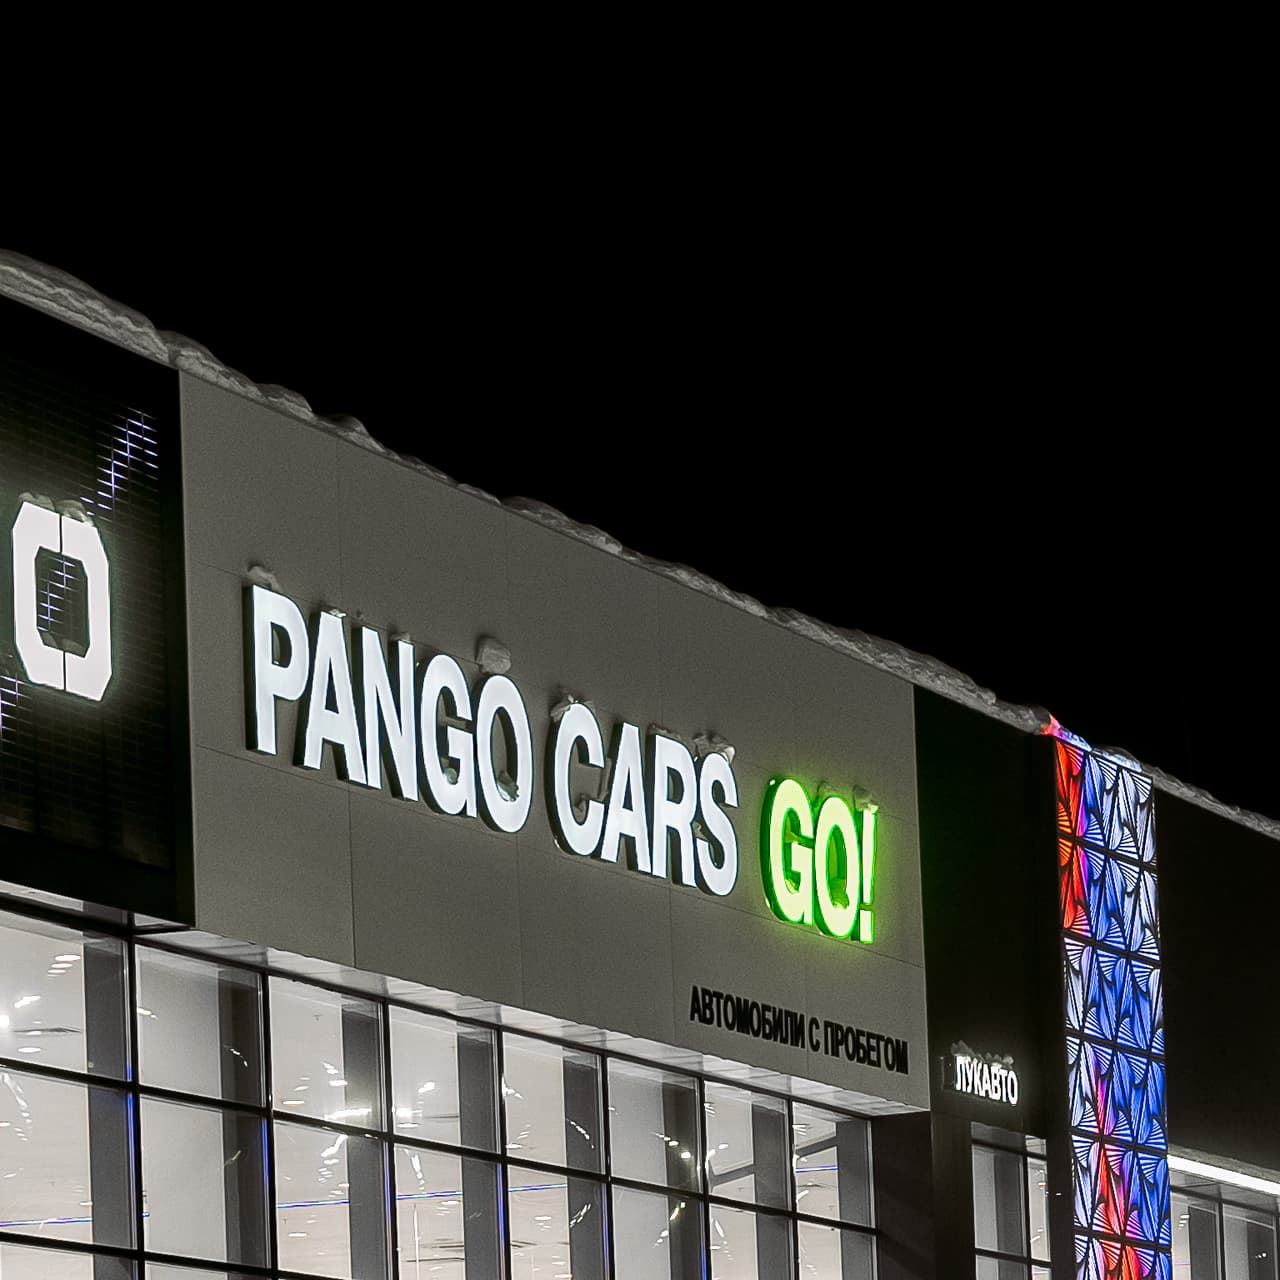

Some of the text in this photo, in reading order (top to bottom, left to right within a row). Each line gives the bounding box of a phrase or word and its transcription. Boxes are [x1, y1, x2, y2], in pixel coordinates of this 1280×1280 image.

[244, 584, 878, 943] PANGO CARS GO!
[690, 985, 909, 1075] АВТОМОБИЛИ С ПРОБЕГОМ
[954, 1054, 1019, 1106] ЛУКАВТО
